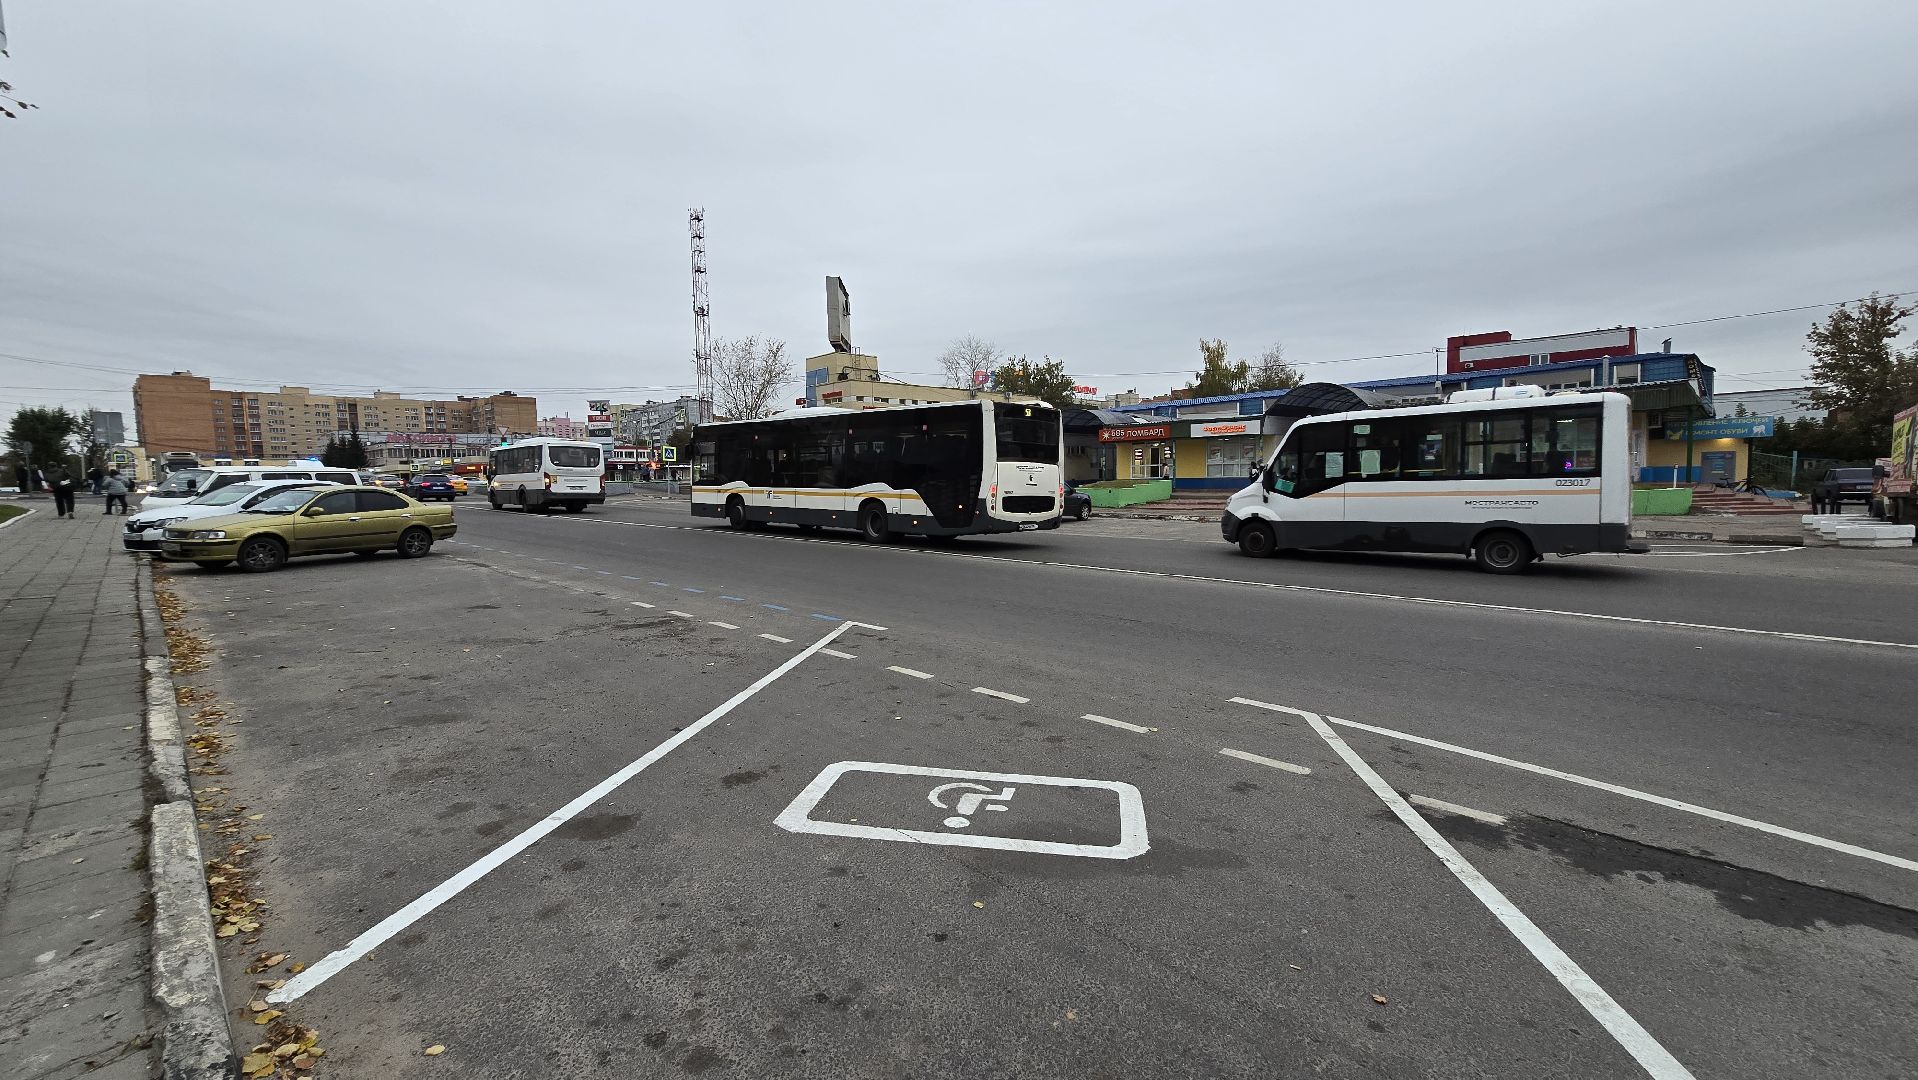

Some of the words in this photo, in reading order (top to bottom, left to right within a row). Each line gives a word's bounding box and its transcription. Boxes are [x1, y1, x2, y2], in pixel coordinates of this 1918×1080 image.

[1126, 428, 1165, 438] ЛОМБАРД
[1719, 427, 1749, 435] ОБУВИ
[1555, 478, 1591, 487] 023017
